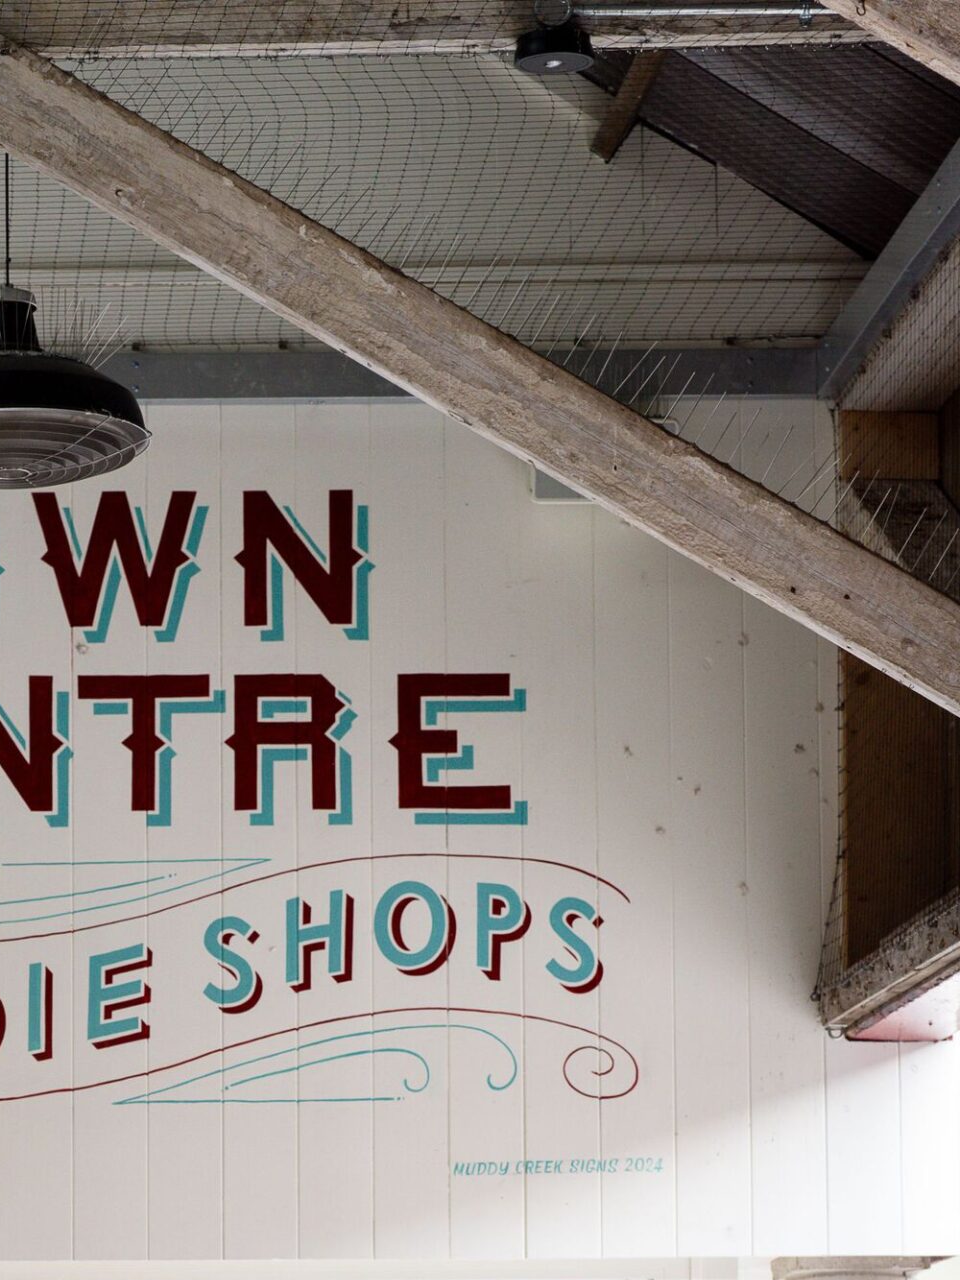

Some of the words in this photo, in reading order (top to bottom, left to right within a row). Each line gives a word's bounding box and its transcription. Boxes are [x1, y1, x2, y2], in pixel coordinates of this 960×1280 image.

[203, 879, 606, 1017] SHOPS
[453, 1161, 509, 1176] MUDDY
[515, 1160, 564, 1175] CREEK
[569, 1158, 619, 1174] SIGNS
[624, 1157, 665, 1173] 2024
